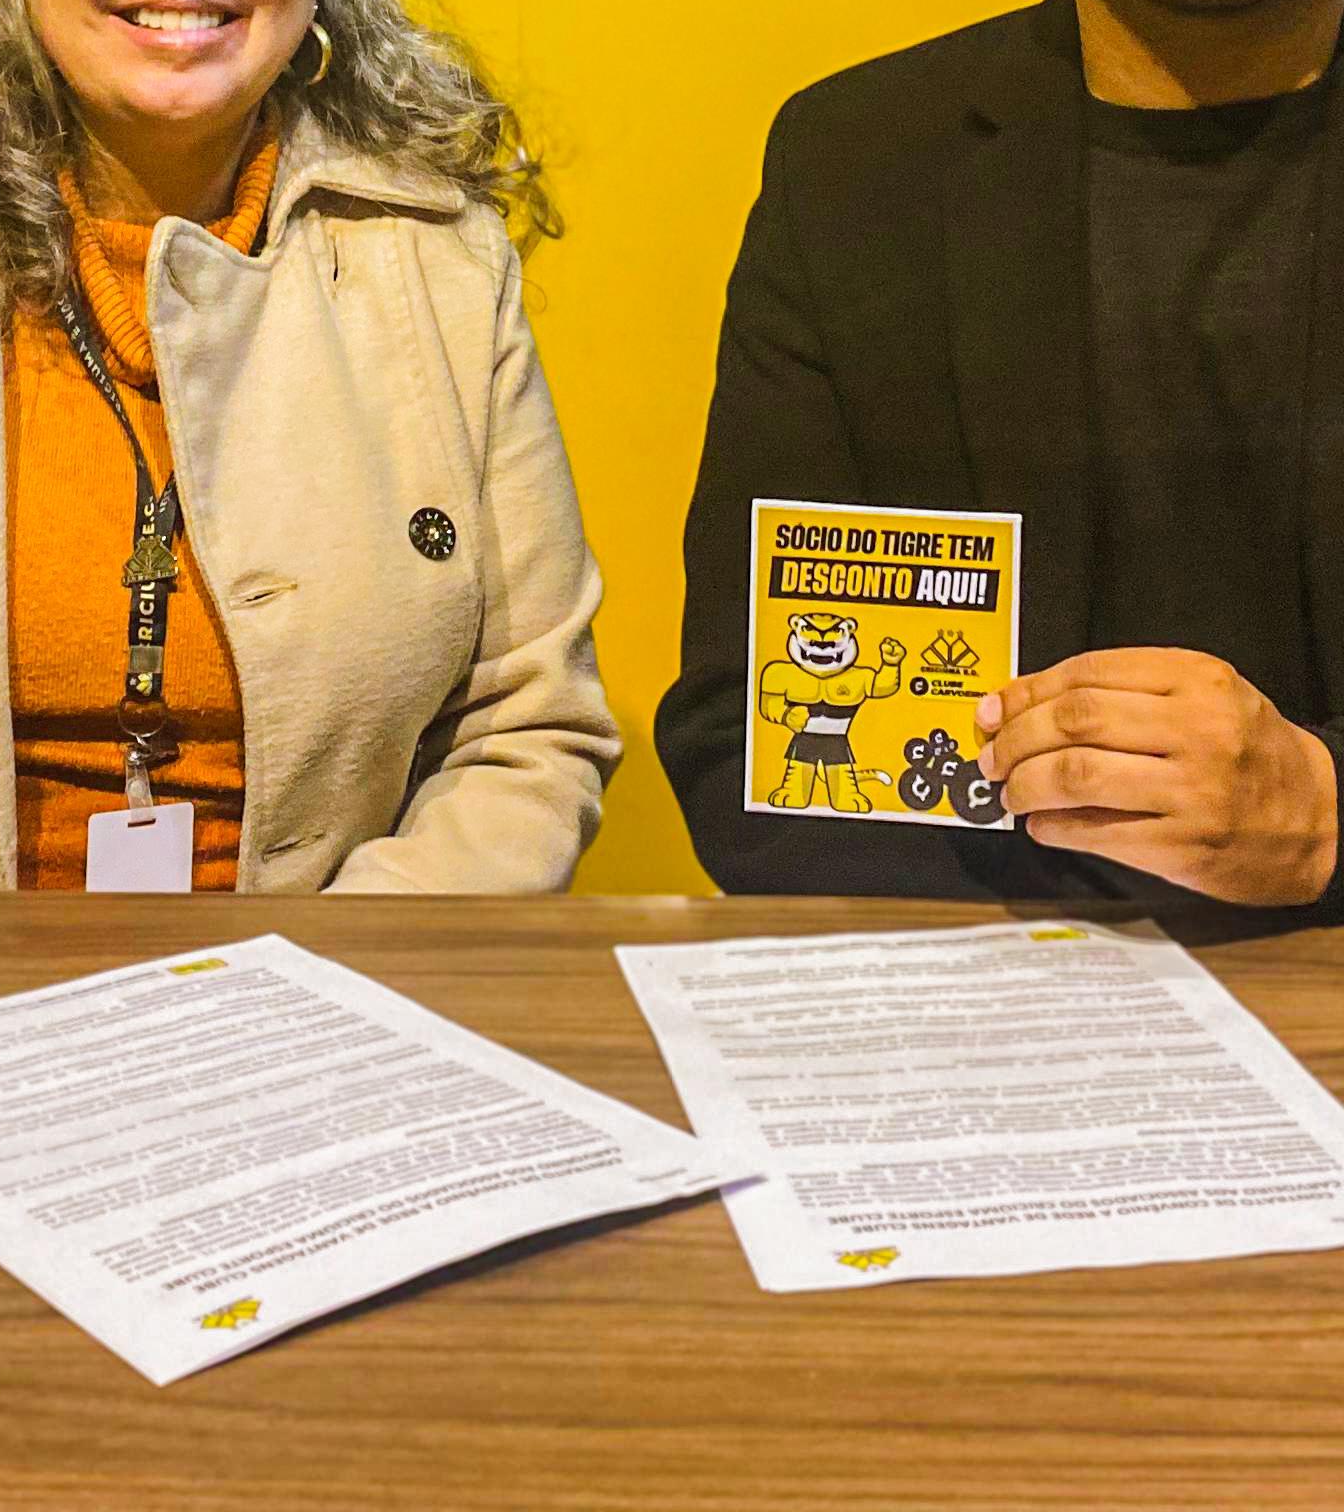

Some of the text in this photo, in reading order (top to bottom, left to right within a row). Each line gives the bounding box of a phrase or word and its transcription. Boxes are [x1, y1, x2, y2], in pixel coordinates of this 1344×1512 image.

[142, 496, 156, 536] E.C.
[776, 522, 995, 562] SÓCIO DO TIGRE TEM
[781, 560, 988, 605] DESCONTO AQUI!
